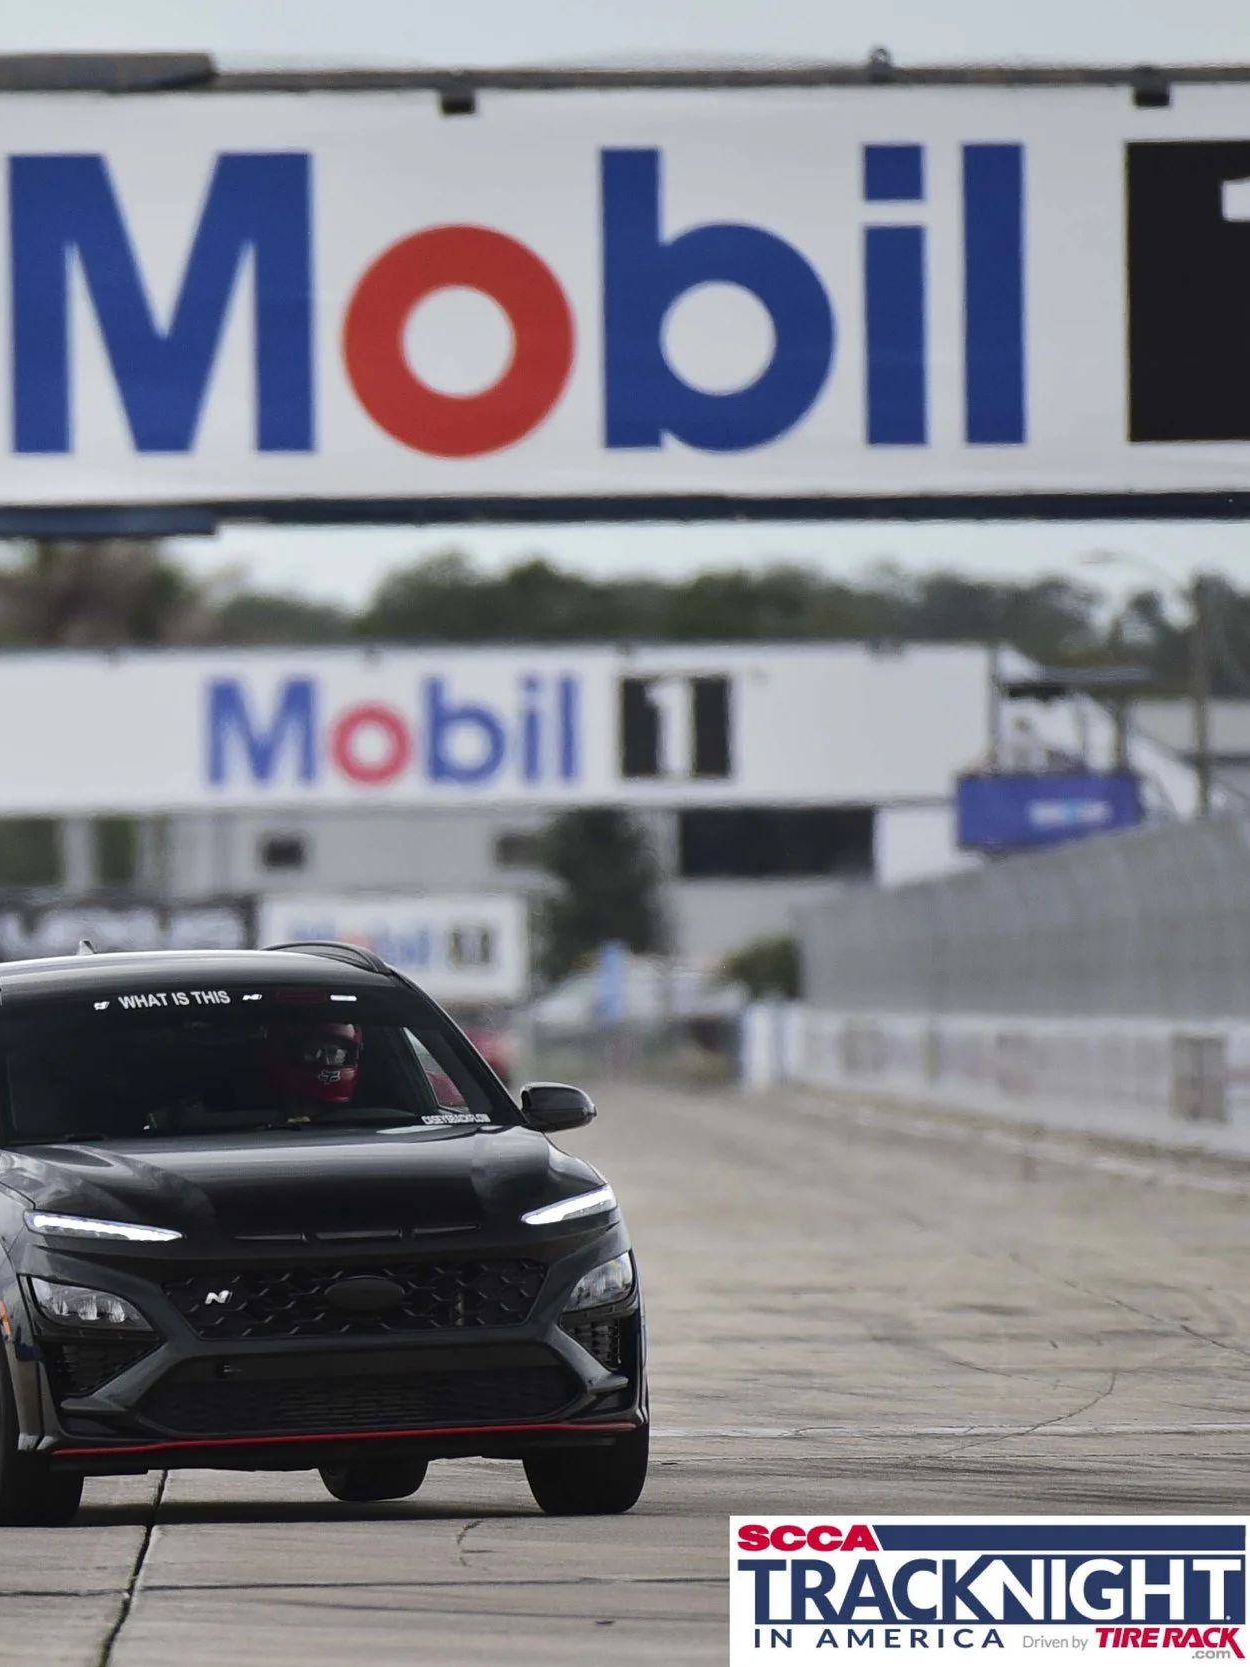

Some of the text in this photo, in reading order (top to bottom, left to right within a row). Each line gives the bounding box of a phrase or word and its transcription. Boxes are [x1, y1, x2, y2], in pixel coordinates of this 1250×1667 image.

[6, 143, 1028, 459] Mobil
[205, 673, 579, 786] Mobil
[118, 993, 168, 1010] WHAT
[171, 992, 190, 1006] IS
[190, 990, 231, 1005] THIS
